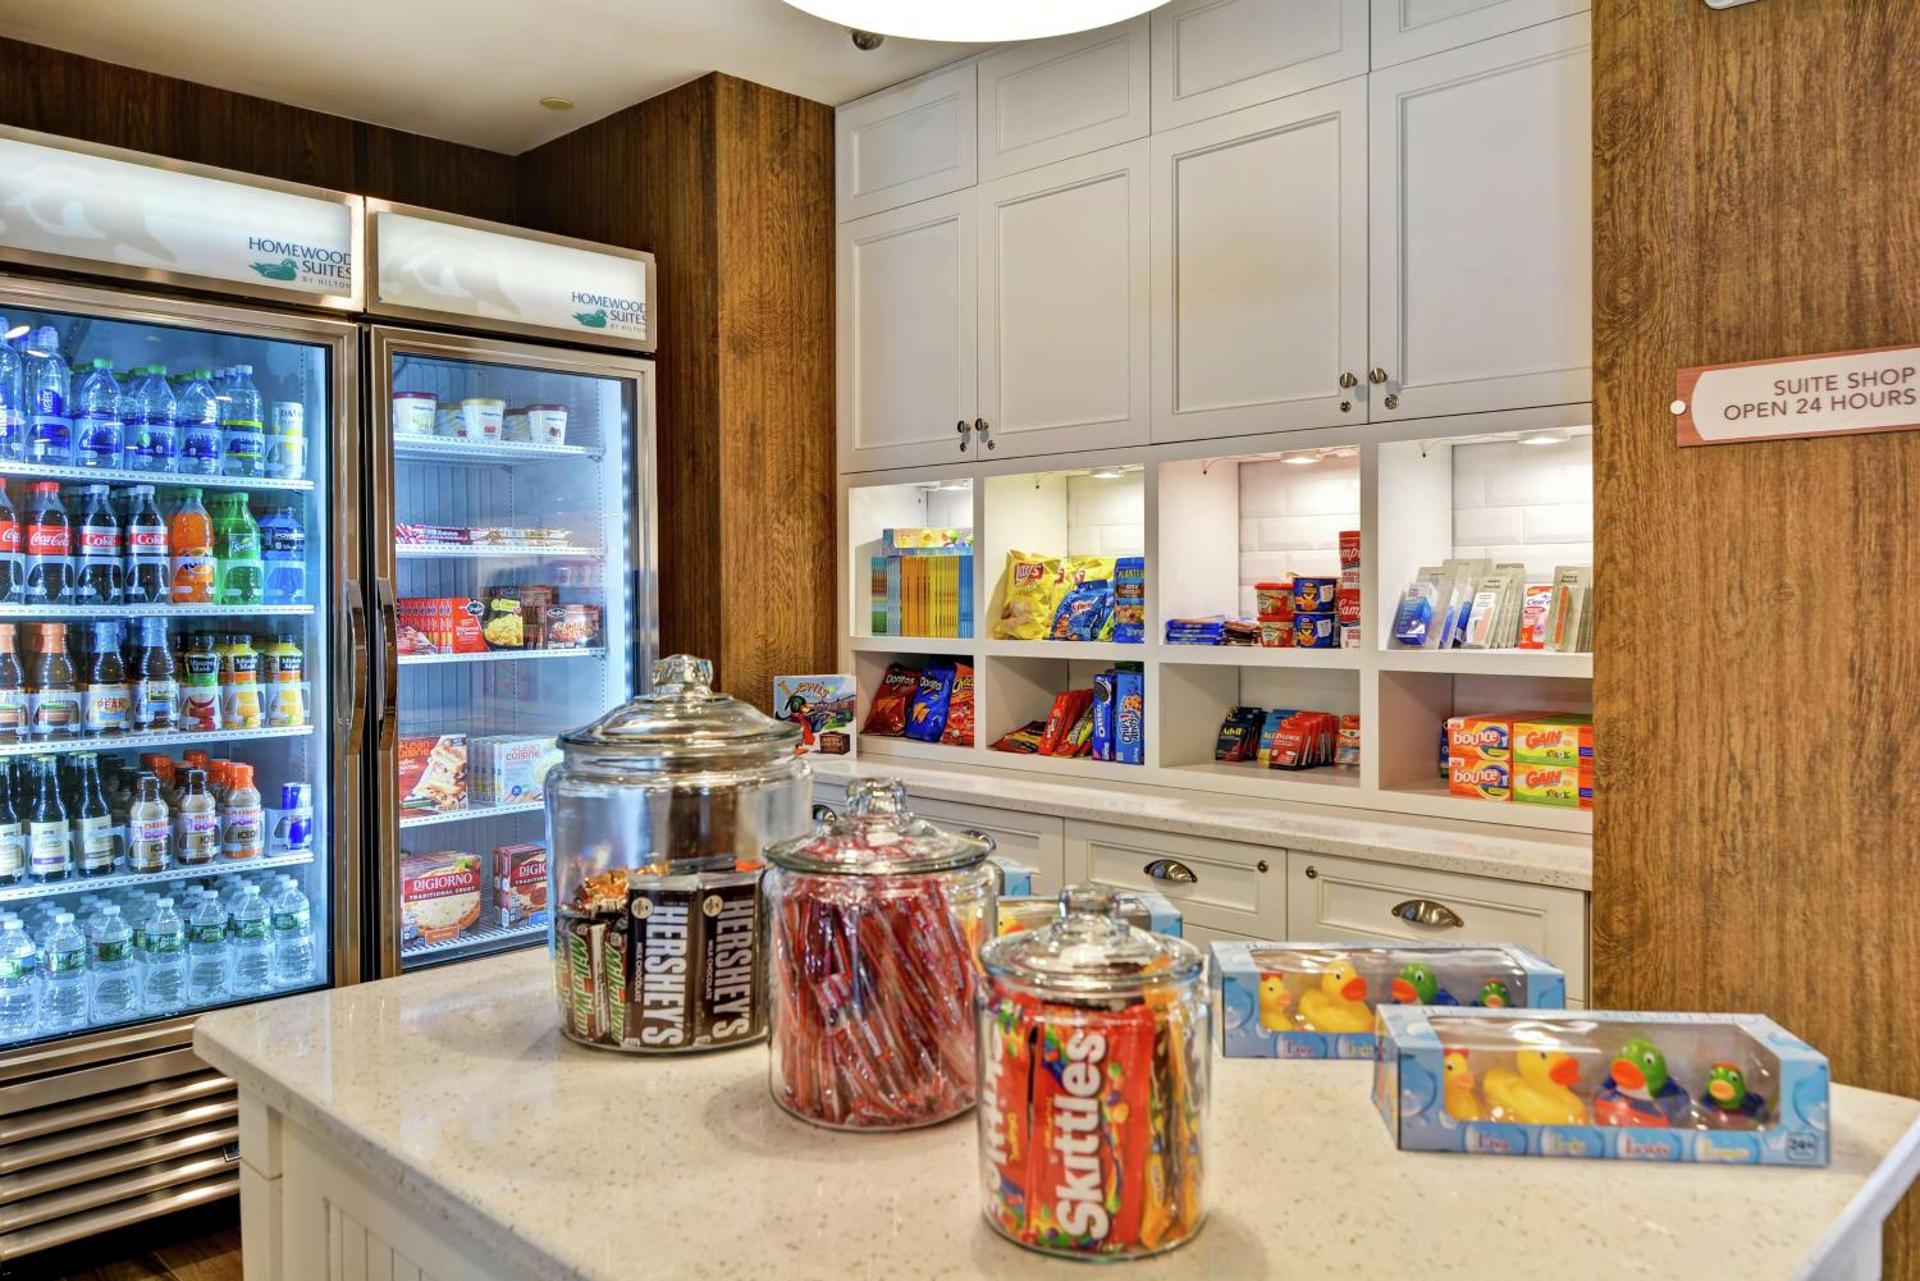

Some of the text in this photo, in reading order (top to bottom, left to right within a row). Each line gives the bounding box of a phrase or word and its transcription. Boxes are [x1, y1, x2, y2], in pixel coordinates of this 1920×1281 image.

[248, 236, 351, 265] HOMEWOOD
[1773, 366, 1916, 397] SUITE SHOP
[1723, 387, 1917, 421] OPEN 24 HOURS
[1453, 730, 1501, 747] bounce
[1453, 767, 1501, 785] bounce
[410, 889, 452, 901] TRADITIONAL
[413, 873, 473, 891] DIGIORNO
[633, 960, 643, 1003] CHOCOLATE
[641, 903, 689, 1045] HERSHEY'S
[712, 898, 755, 1039] HERSHEY'S
[1055, 1027, 1110, 1241] Skittles
